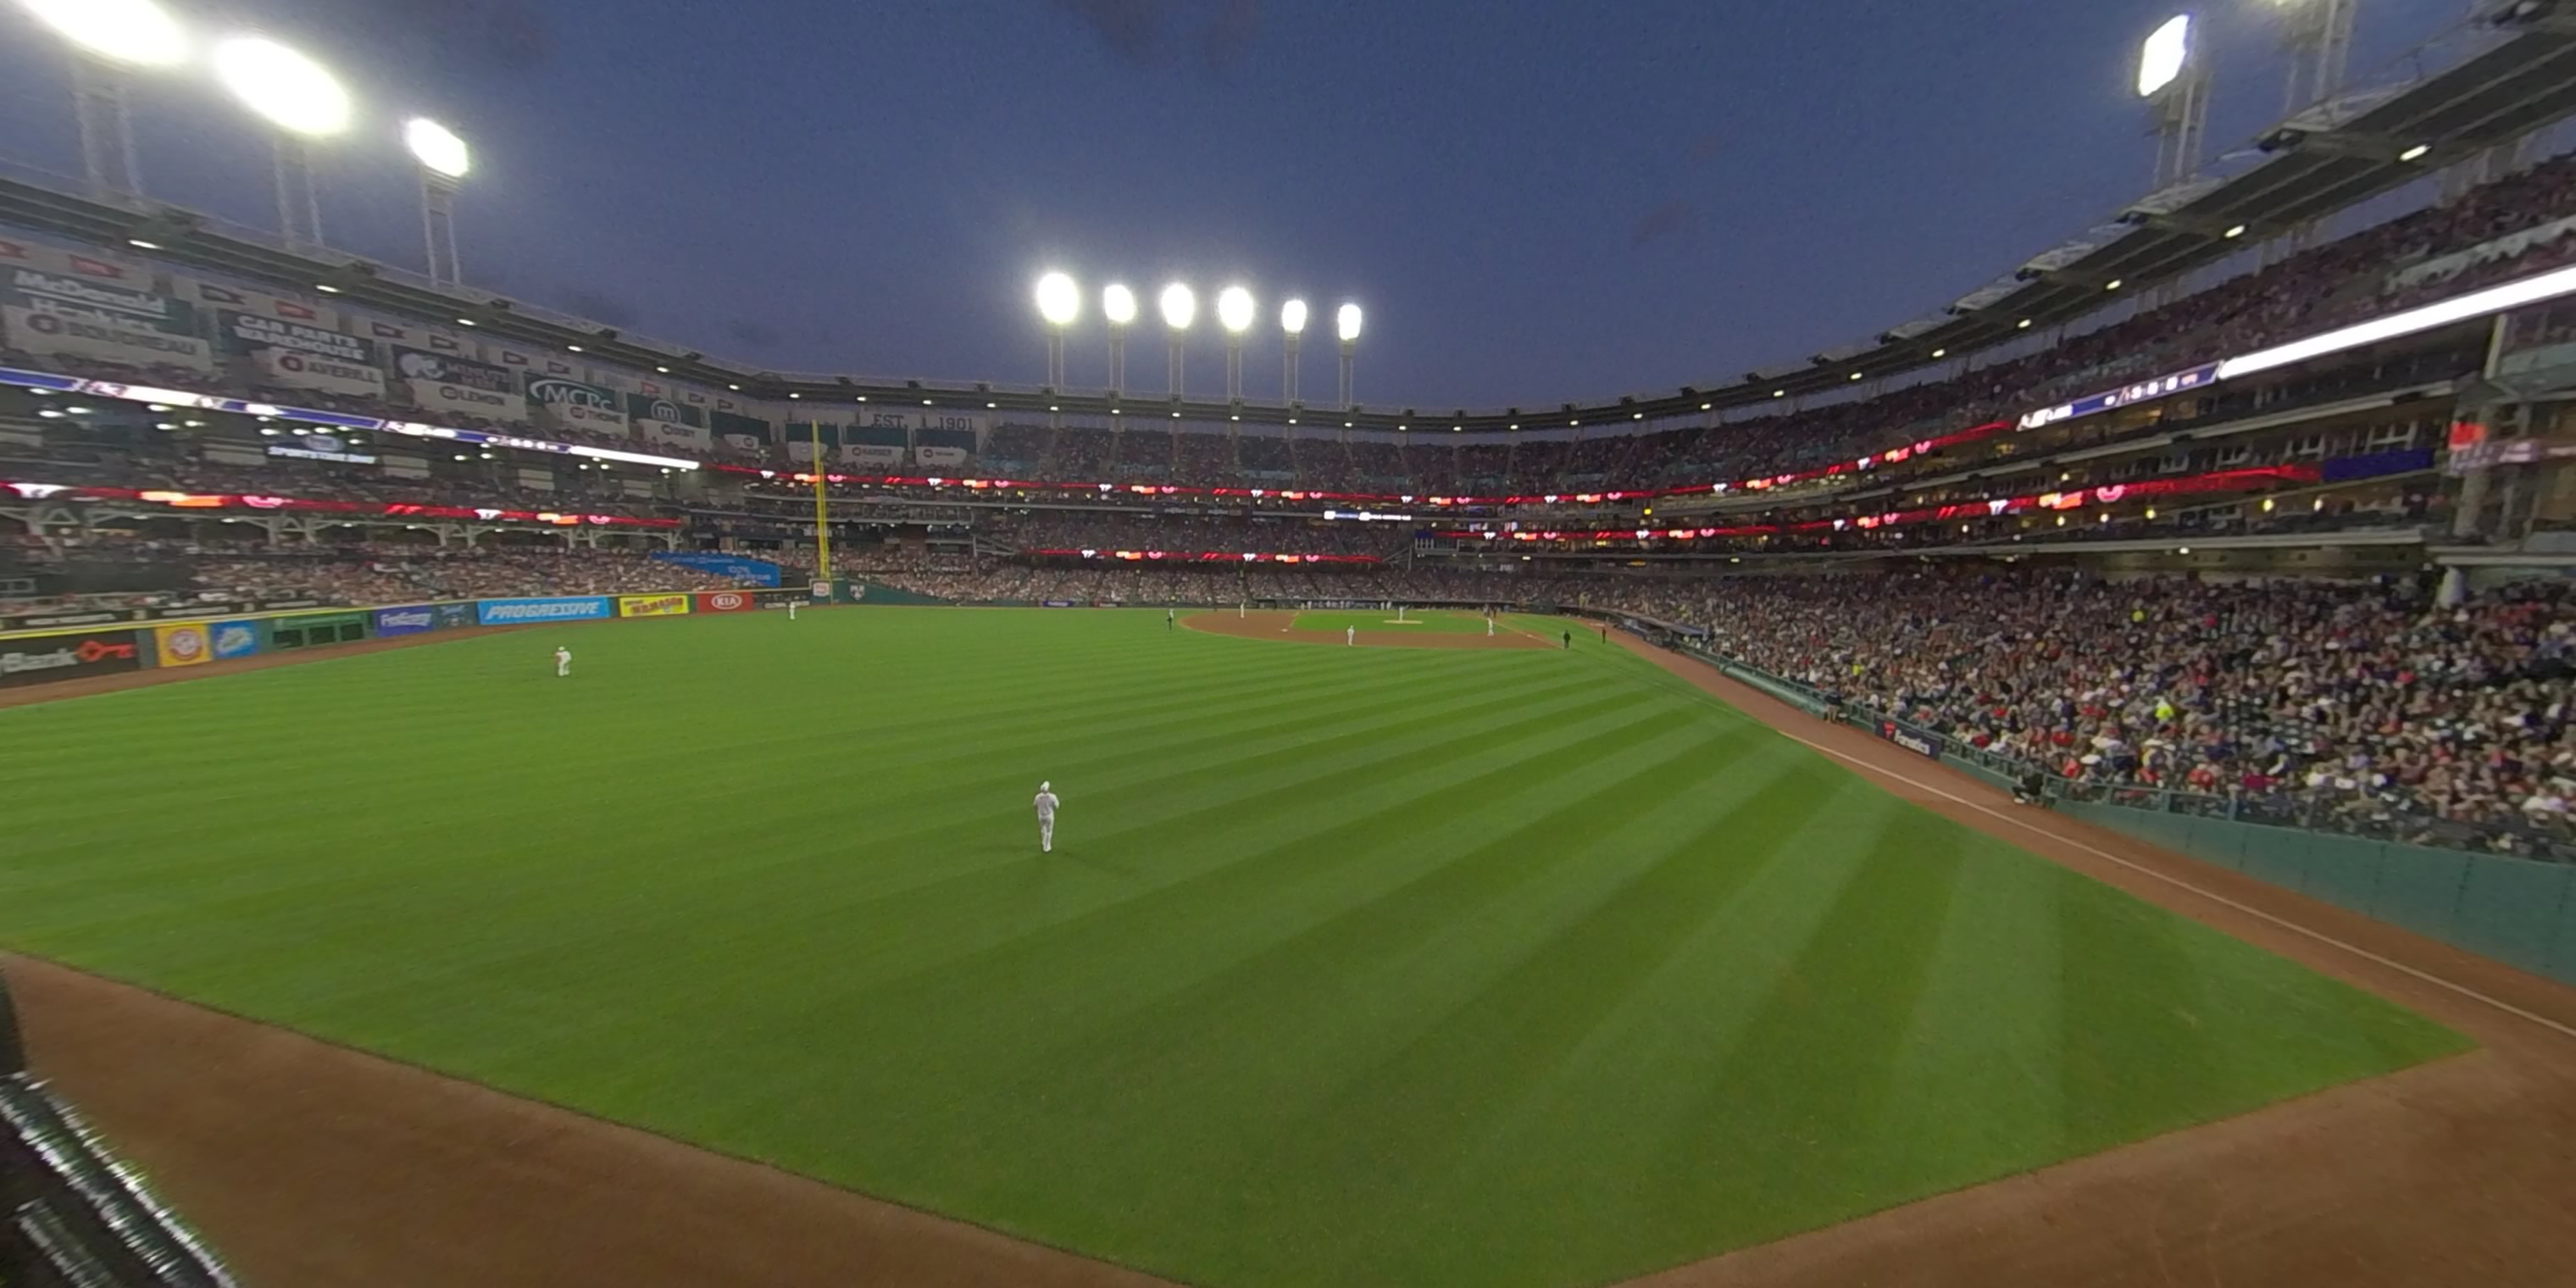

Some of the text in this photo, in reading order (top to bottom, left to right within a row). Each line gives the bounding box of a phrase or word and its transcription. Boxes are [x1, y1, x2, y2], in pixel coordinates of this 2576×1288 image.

[237, 315, 286, 334] CAR
[938, 417, 974, 430] 1901
[716, 597, 738, 607] KIA
[486, 602, 601, 619] PROGRESSIVE
